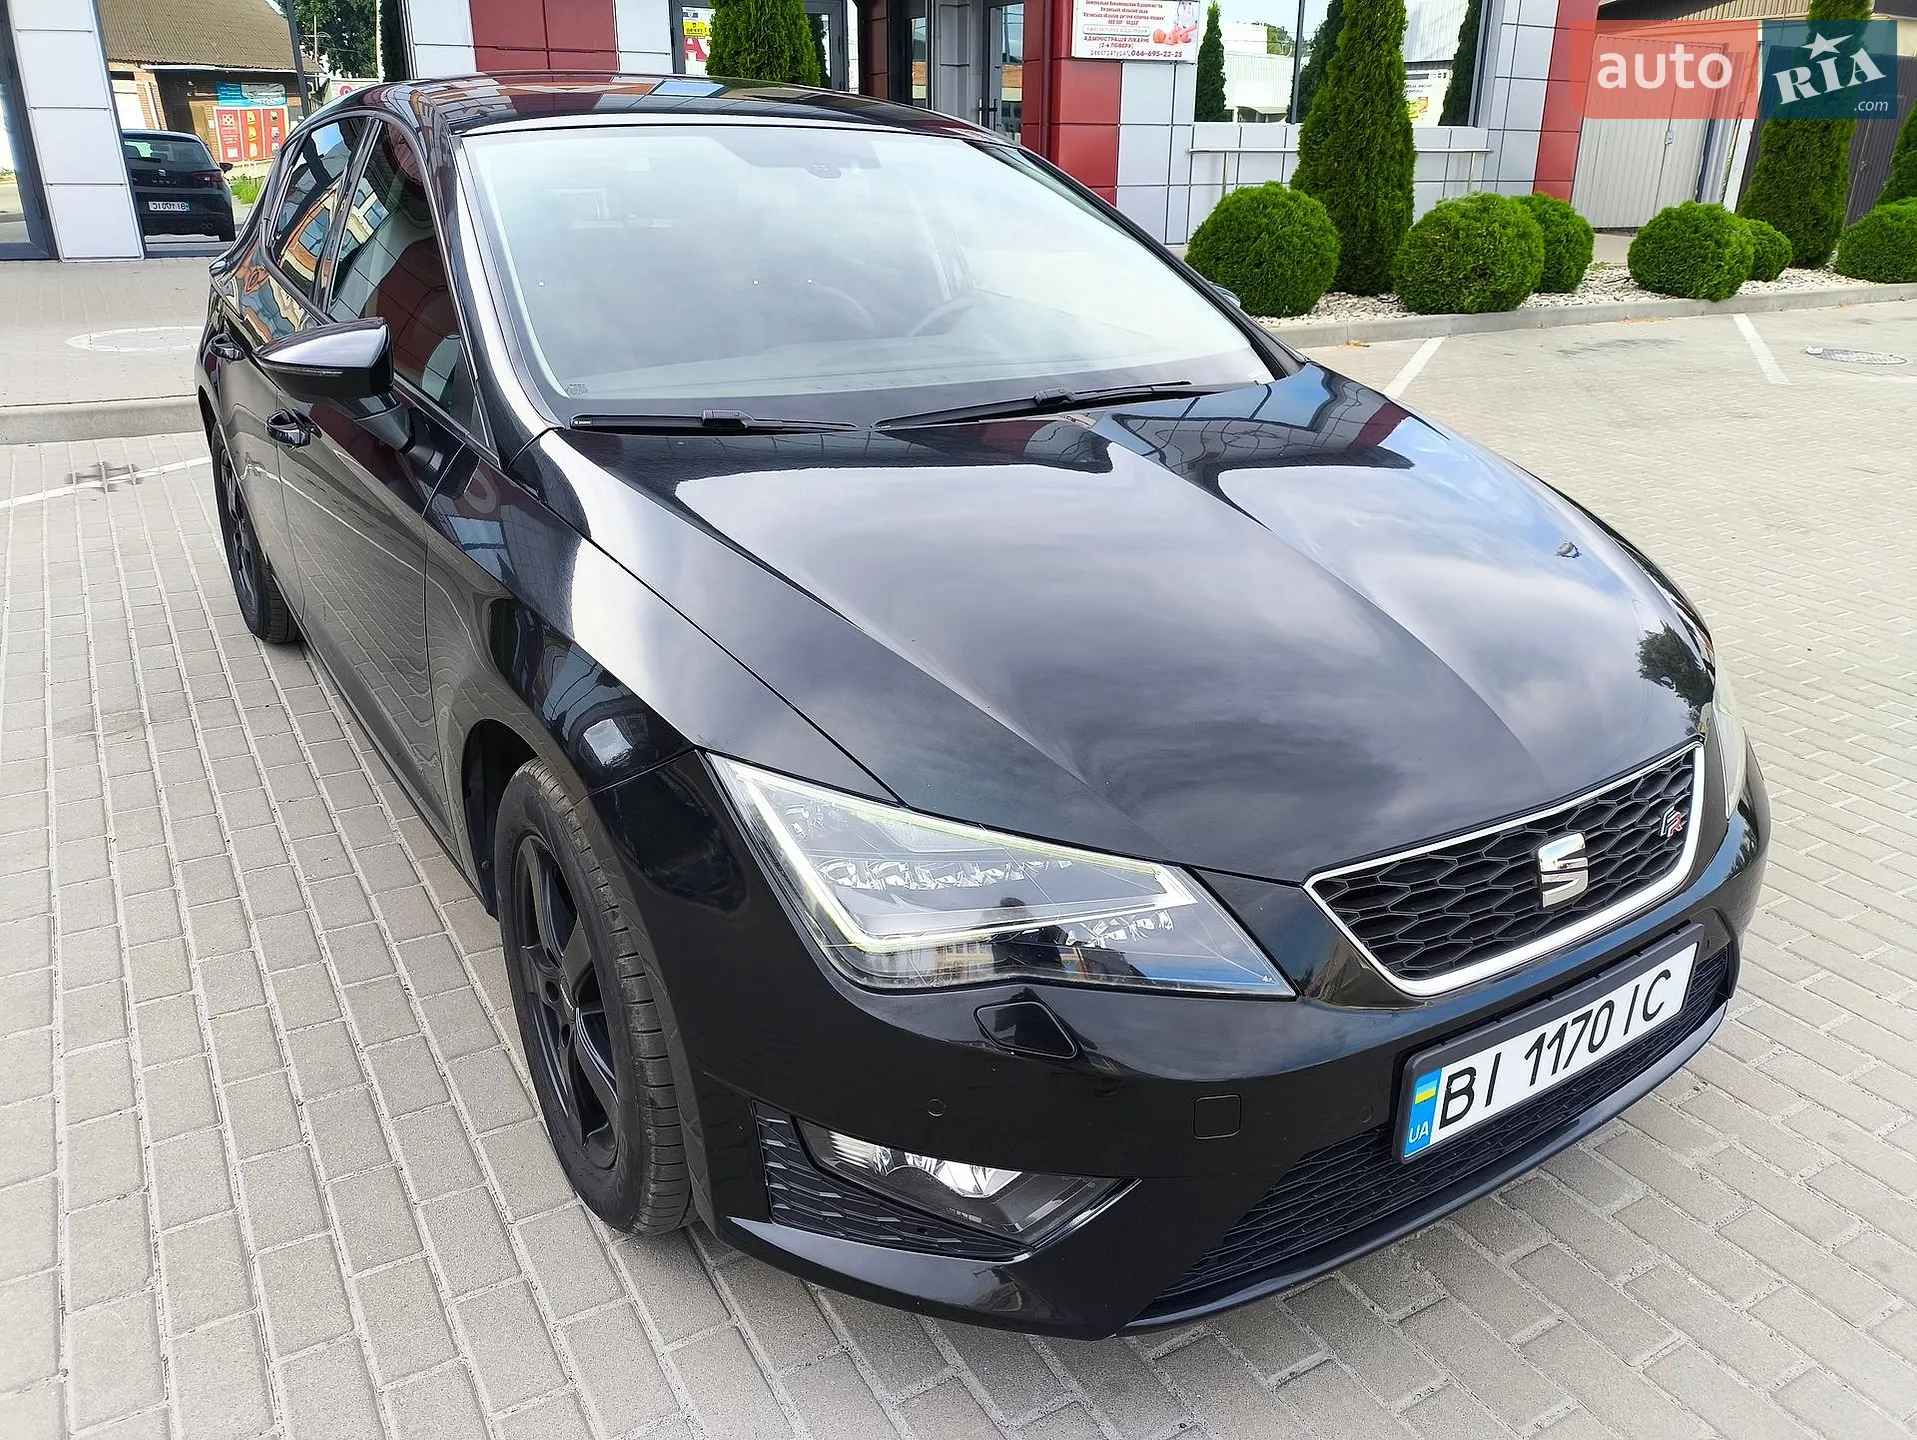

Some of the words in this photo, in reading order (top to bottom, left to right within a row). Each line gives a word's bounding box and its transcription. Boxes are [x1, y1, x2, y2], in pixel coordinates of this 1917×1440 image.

[1438, 1053, 1502, 1130] BI
[1524, 1004, 1616, 1087] 1170
[1622, 968, 1672, 1036] IC
[1408, 1124, 1430, 1144] UA
